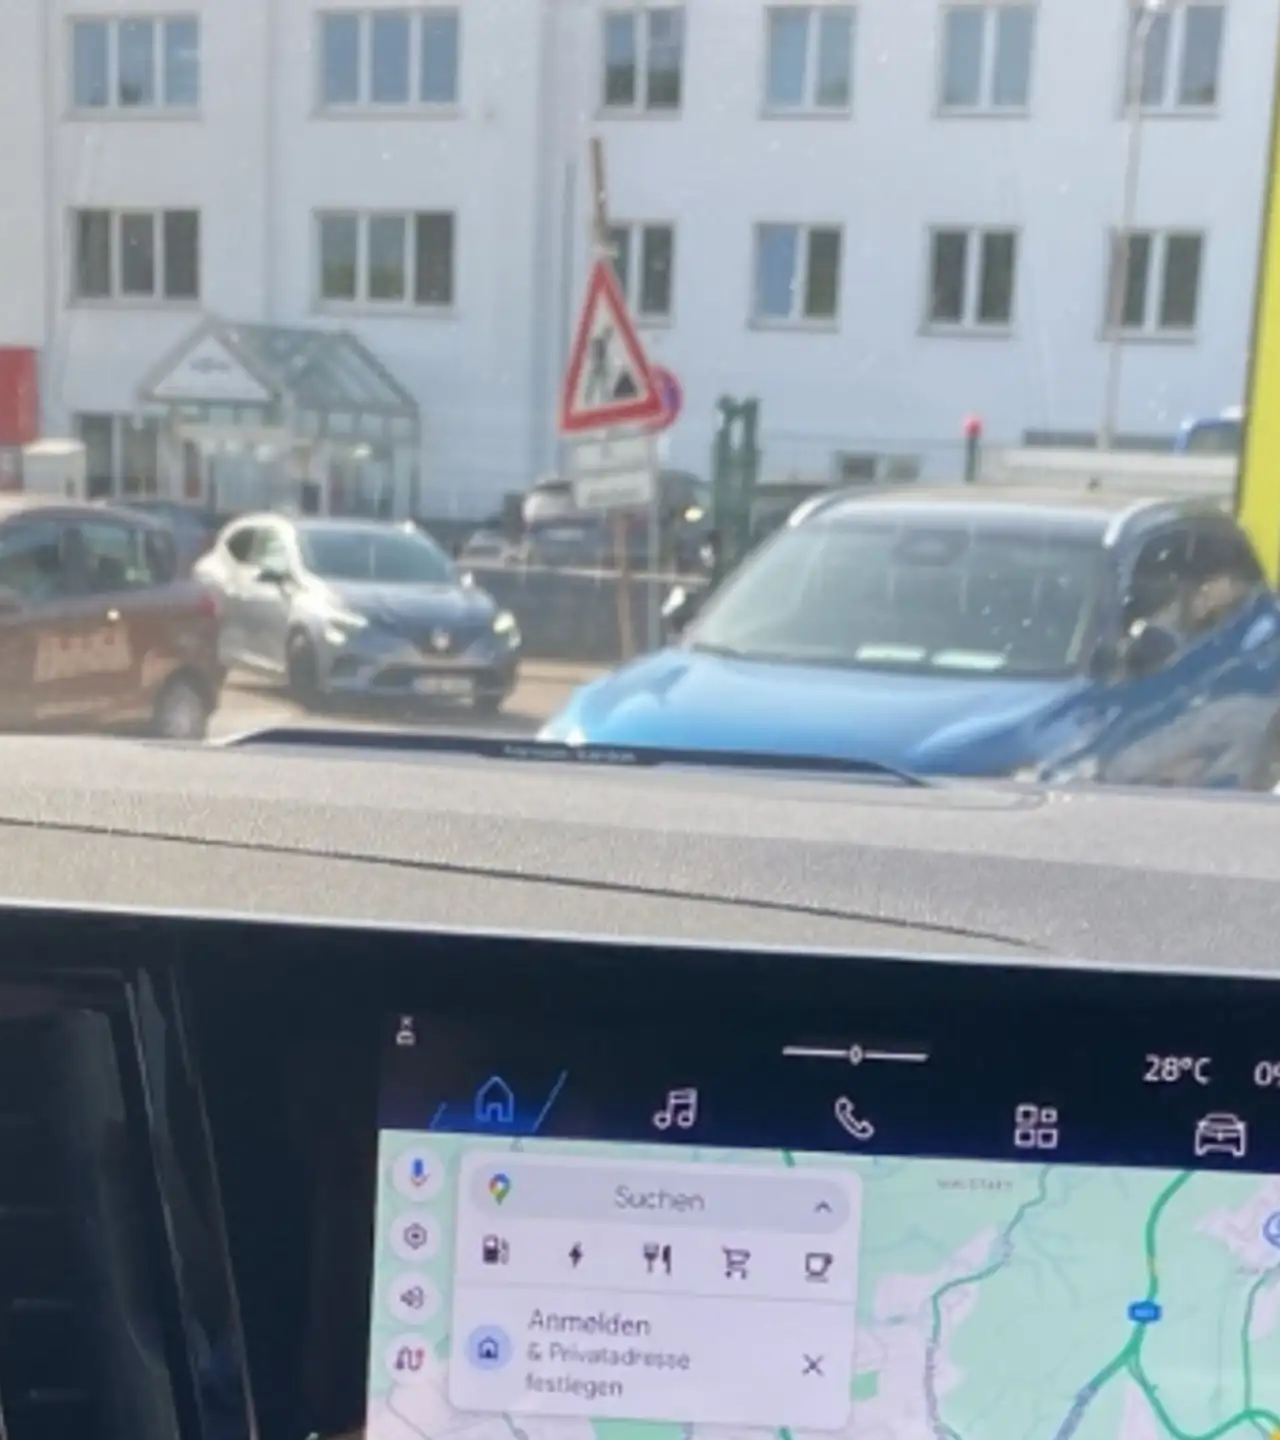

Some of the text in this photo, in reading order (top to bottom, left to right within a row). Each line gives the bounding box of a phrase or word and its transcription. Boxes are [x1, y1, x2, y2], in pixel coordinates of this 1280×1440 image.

[1143, 1053, 1212, 1084] 28°C
[614, 1185, 705, 1212] Suchen
[527, 1309, 651, 1337] Anmelden
[549, 1343, 691, 1371] Privatadresse
[525, 1373, 623, 1399] festlegen
